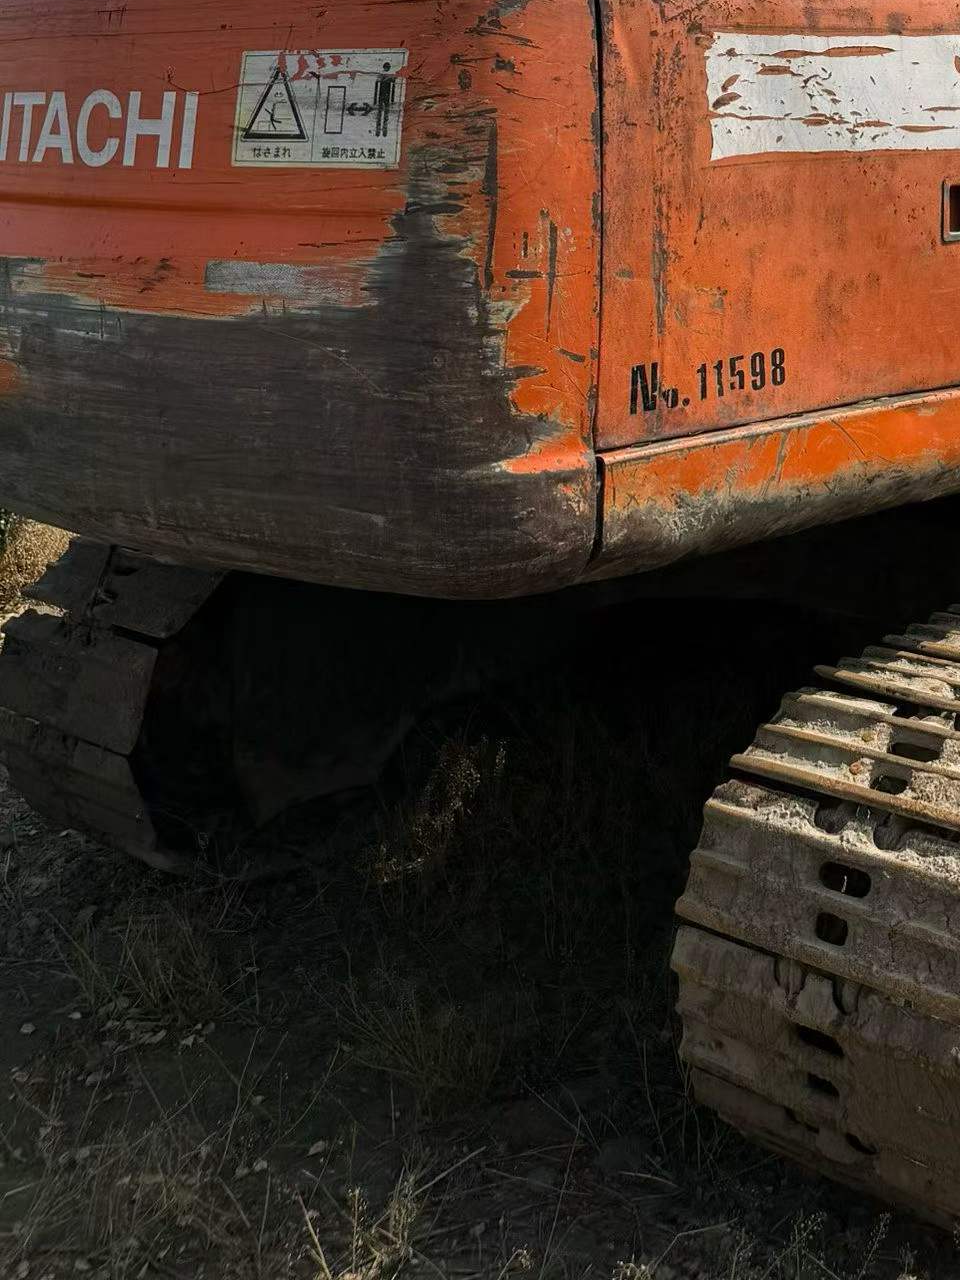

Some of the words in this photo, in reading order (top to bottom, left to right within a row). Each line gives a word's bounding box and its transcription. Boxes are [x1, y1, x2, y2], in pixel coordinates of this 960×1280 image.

[0, 89, 200, 169] ITACHI
[252, 146, 292, 159] はさまれ
[629, 361, 690, 415] No.
[696, 347, 786, 401] 11598
